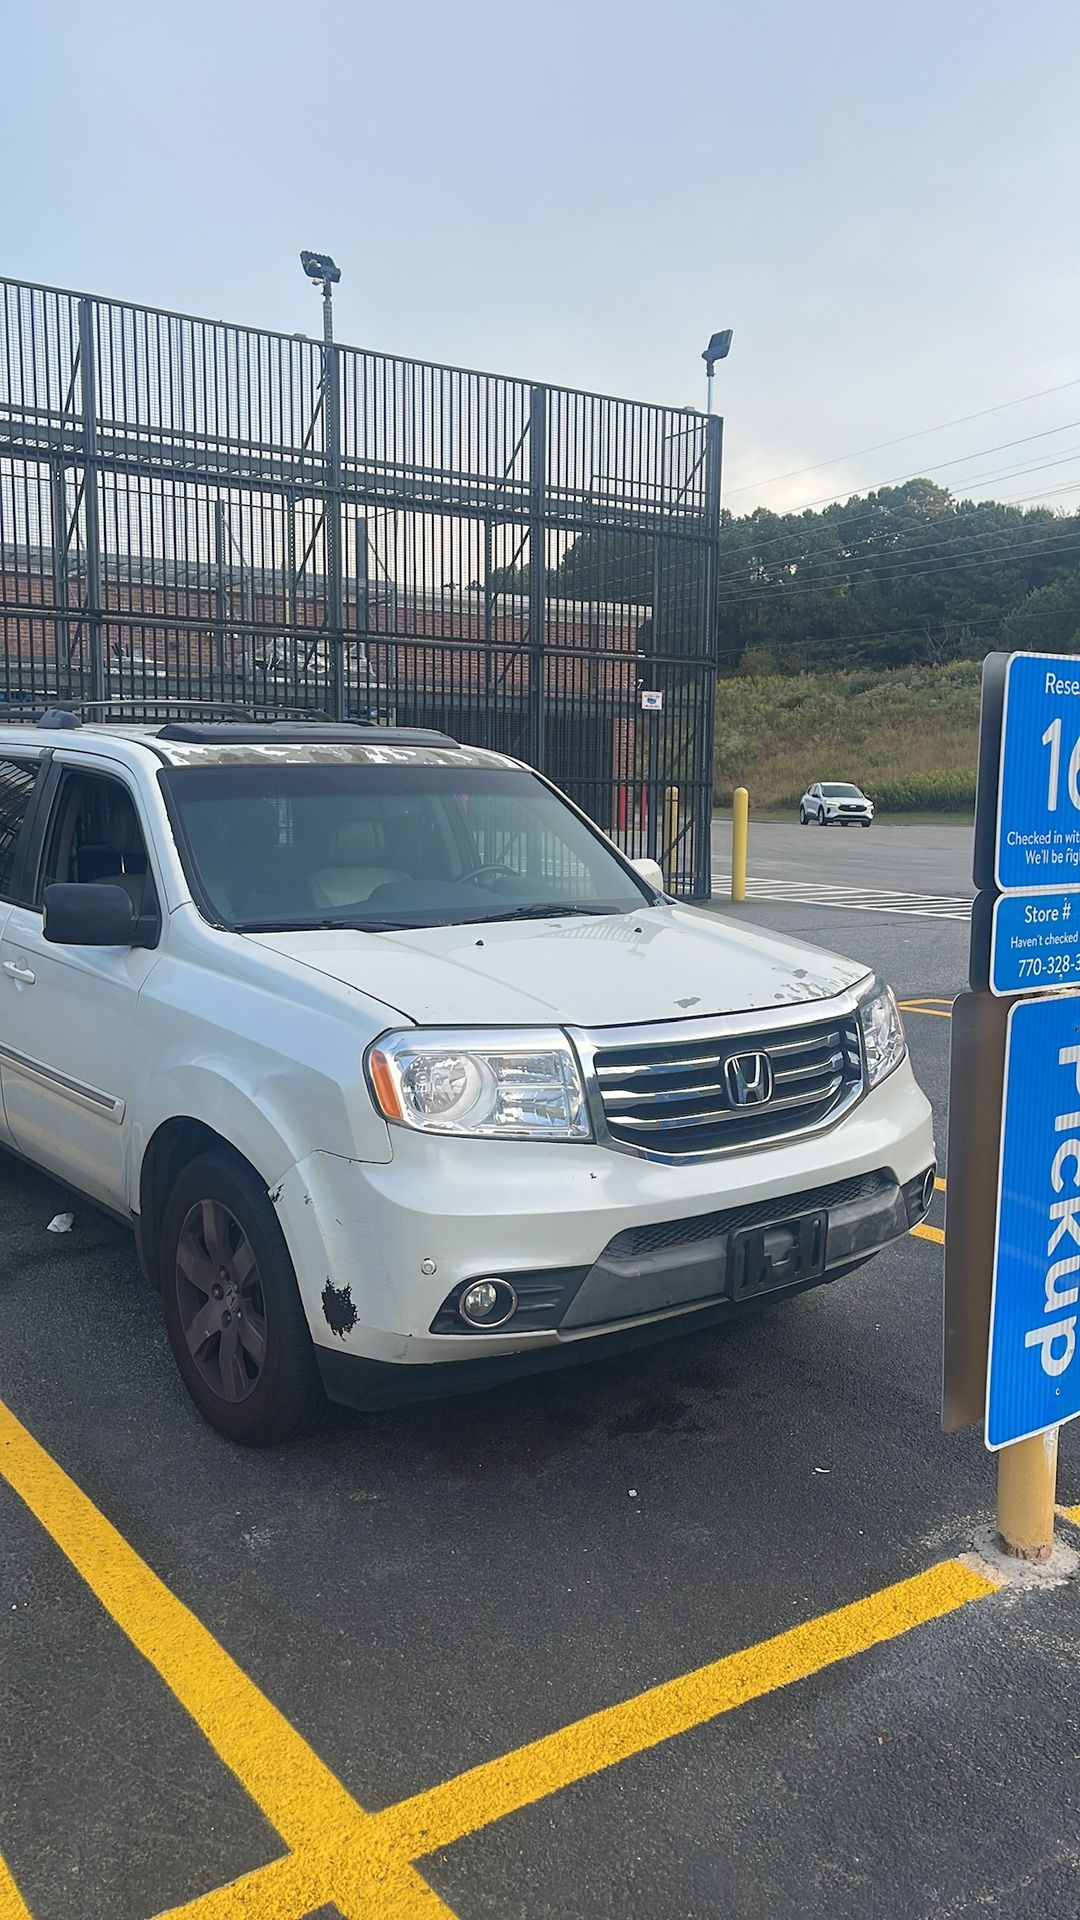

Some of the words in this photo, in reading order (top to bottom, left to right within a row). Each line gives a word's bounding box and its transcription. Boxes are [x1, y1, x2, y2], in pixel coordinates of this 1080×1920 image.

[1007, 830, 1051, 846] Checked
[1053, 830, 1063, 844] in
[1025, 849, 1049, 865] We'll
[1051, 849, 1063, 864] be
[1066, 849, 1080, 866] rig
[1024, 905, 1059, 924] Store
[1062, 902, 1071, 920] #
[1010, 934, 1043, 949] Haven't
[1044, 930, 1079, 946] checked
